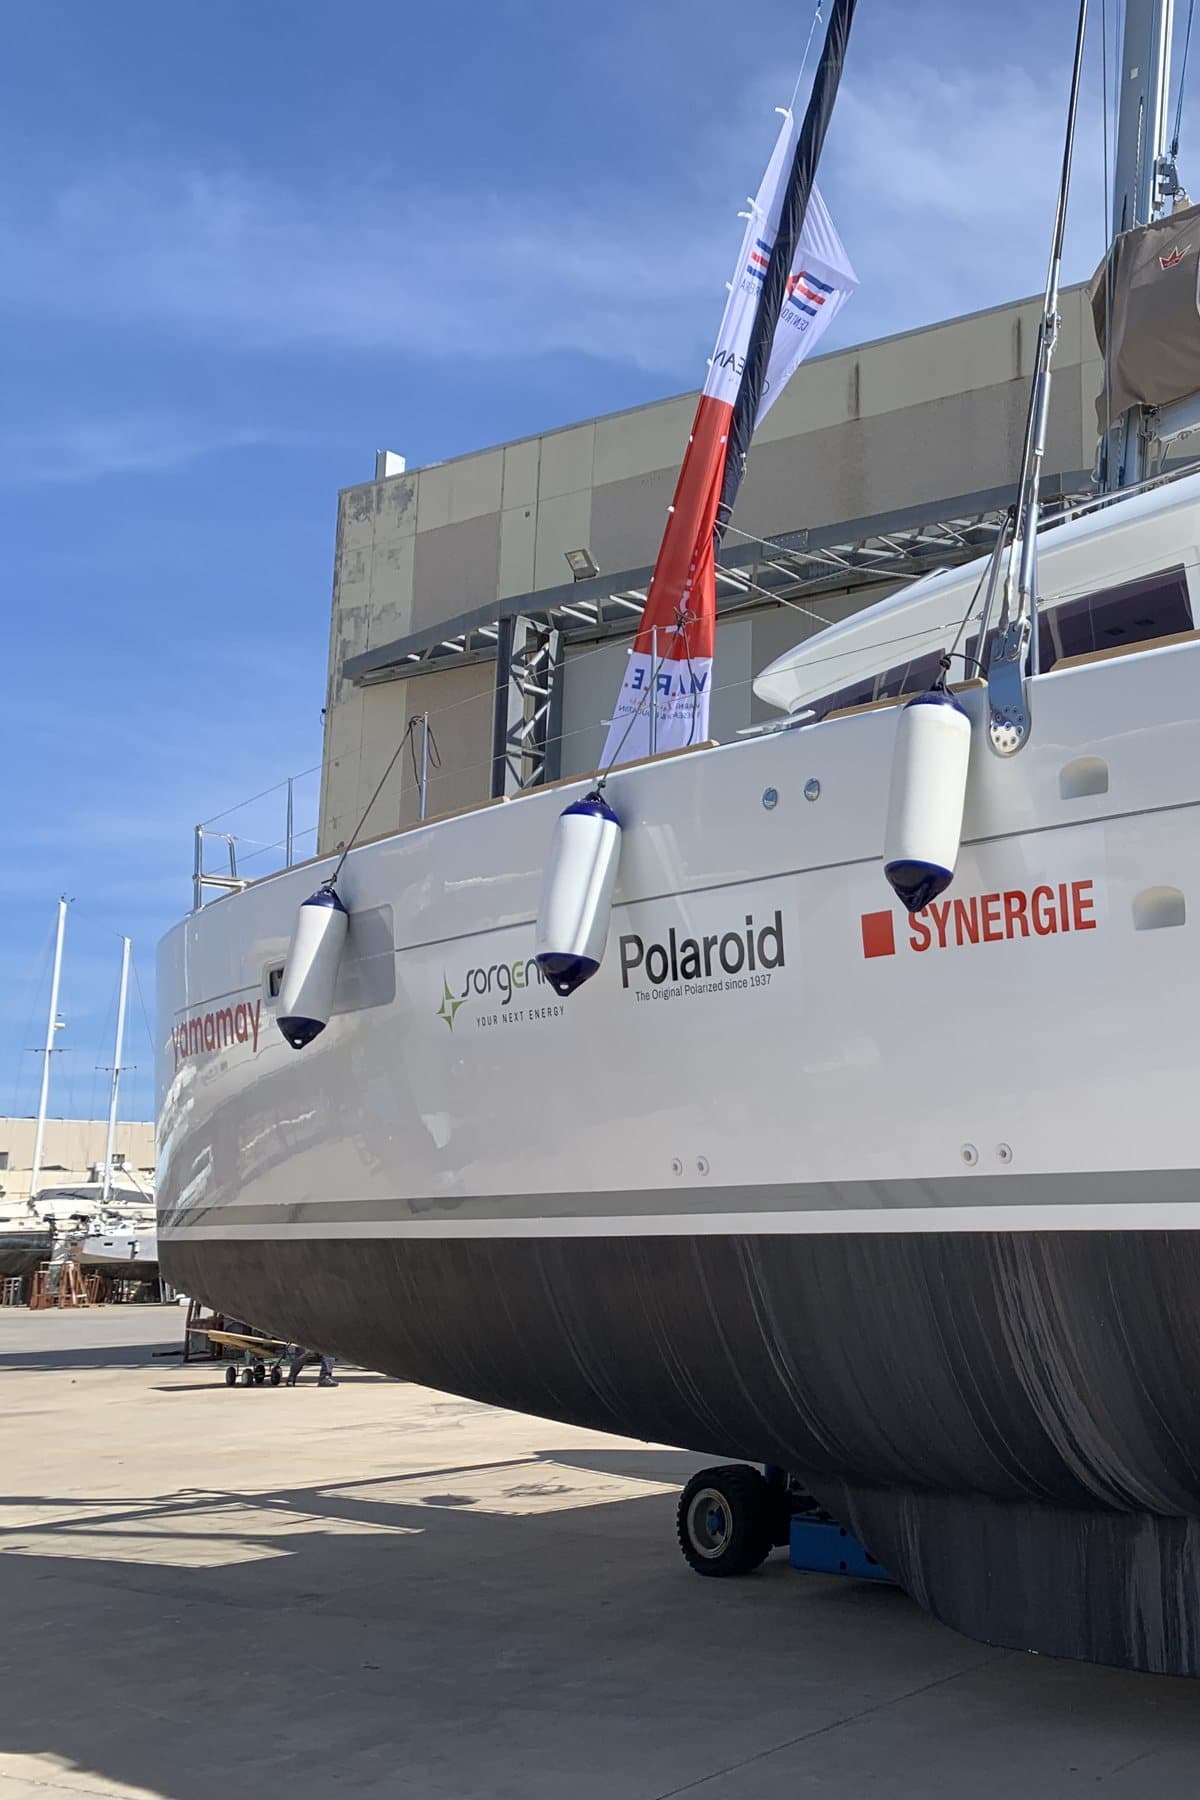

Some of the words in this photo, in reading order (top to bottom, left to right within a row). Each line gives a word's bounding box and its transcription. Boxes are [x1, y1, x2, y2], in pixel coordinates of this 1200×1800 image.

[908, 879, 1097, 952] SYNERGIE
[619, 910, 785, 989] Polaroid
[461, 958, 547, 1006] sorgen
[636, 990, 651, 1003] The
[652, 985, 683, 1001] Original
[684, 980, 724, 996] Polarized
[725, 978, 749, 991] since
[750, 973, 772, 988] 1937
[171, 999, 262, 1073] yamamay
[476, 1015, 499, 1028] YOUR
[502, 1010, 524, 1023] NEXT
[529, 1004, 565, 1020] ENERGY
